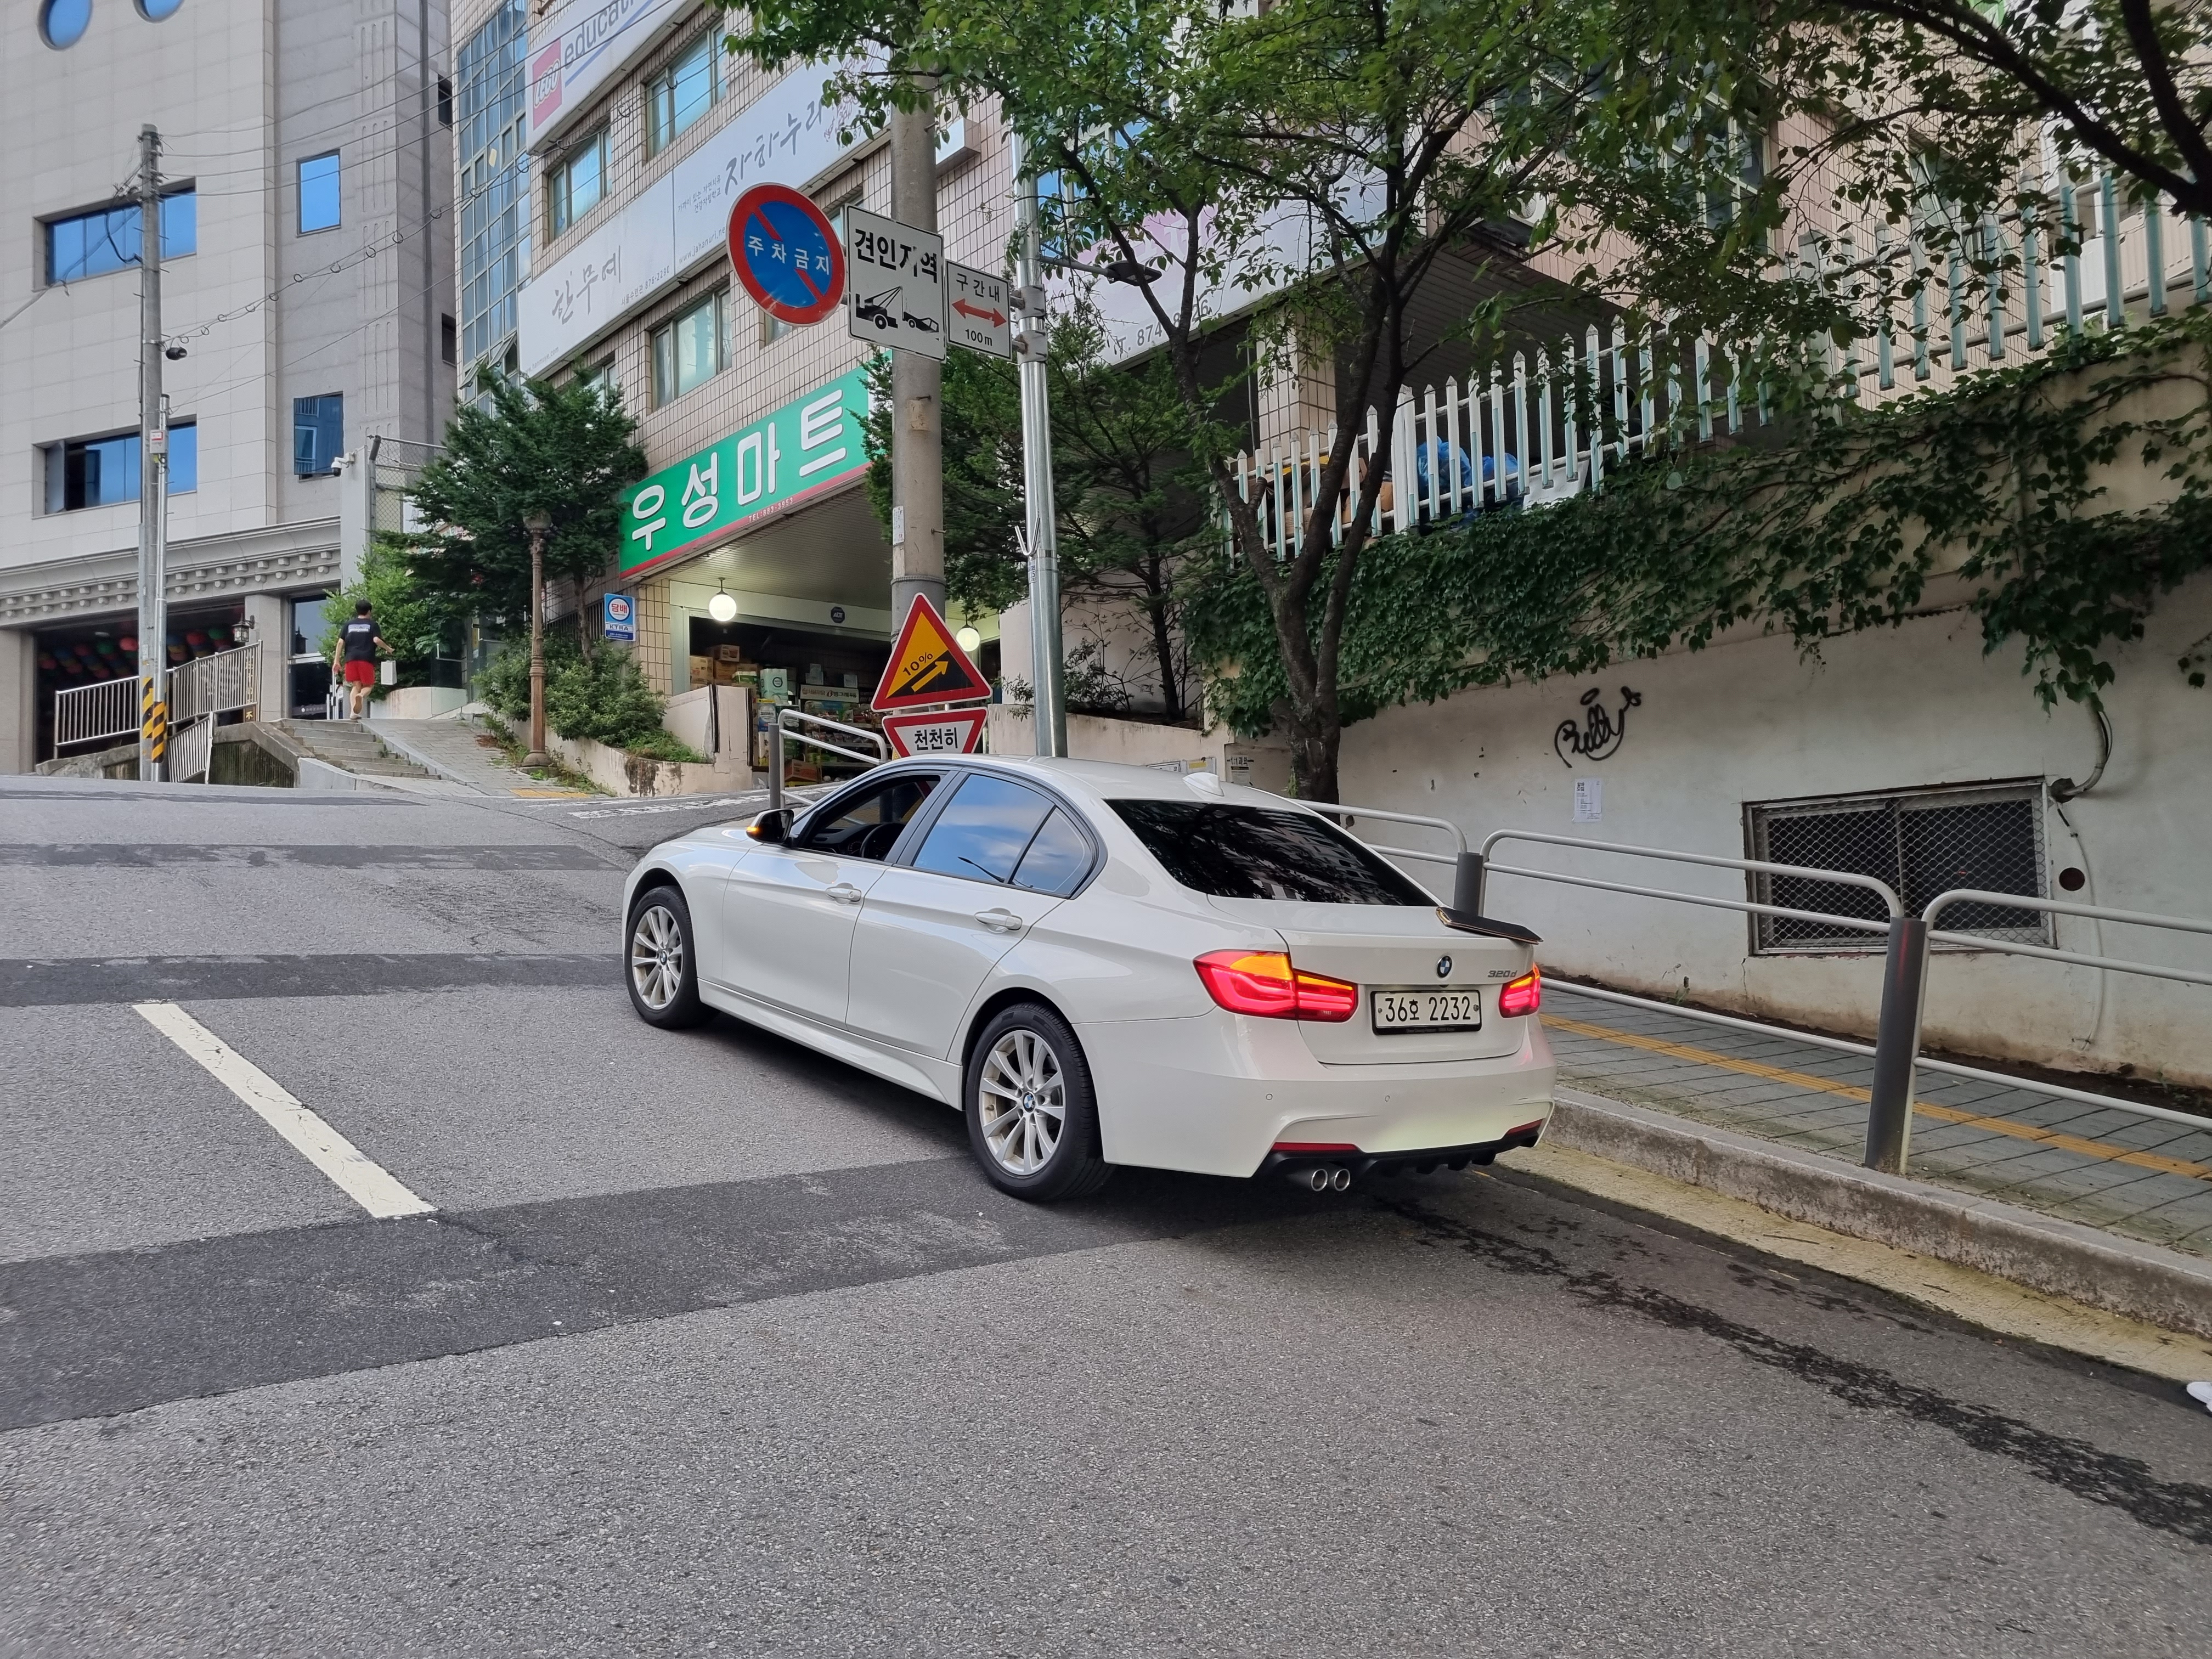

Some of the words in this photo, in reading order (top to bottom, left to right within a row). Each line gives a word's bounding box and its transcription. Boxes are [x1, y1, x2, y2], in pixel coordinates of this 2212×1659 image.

[534, 59, 561, 109] LEGO
[565, 0, 634, 70] educa
[725, 94, 823, 196] 자하누리
[678, 226, 726, 264] www.jahanuri.ne
[748, 235, 830, 275] 주차금지
[854, 228, 938, 284] 견인지역
[552, 245, 621, 325] 한무예
[956, 273, 1000, 303] 구간내
[964, 329, 993, 347] 100m
[631, 388, 848, 551] 우성마트
[611, 603, 628, 614] 담배
[902, 652, 934, 676] 10%
[914, 727, 958, 751] 천천히
[1385, 997, 1420, 1023] 36호
[1428, 996, 1471, 1021] 2232
